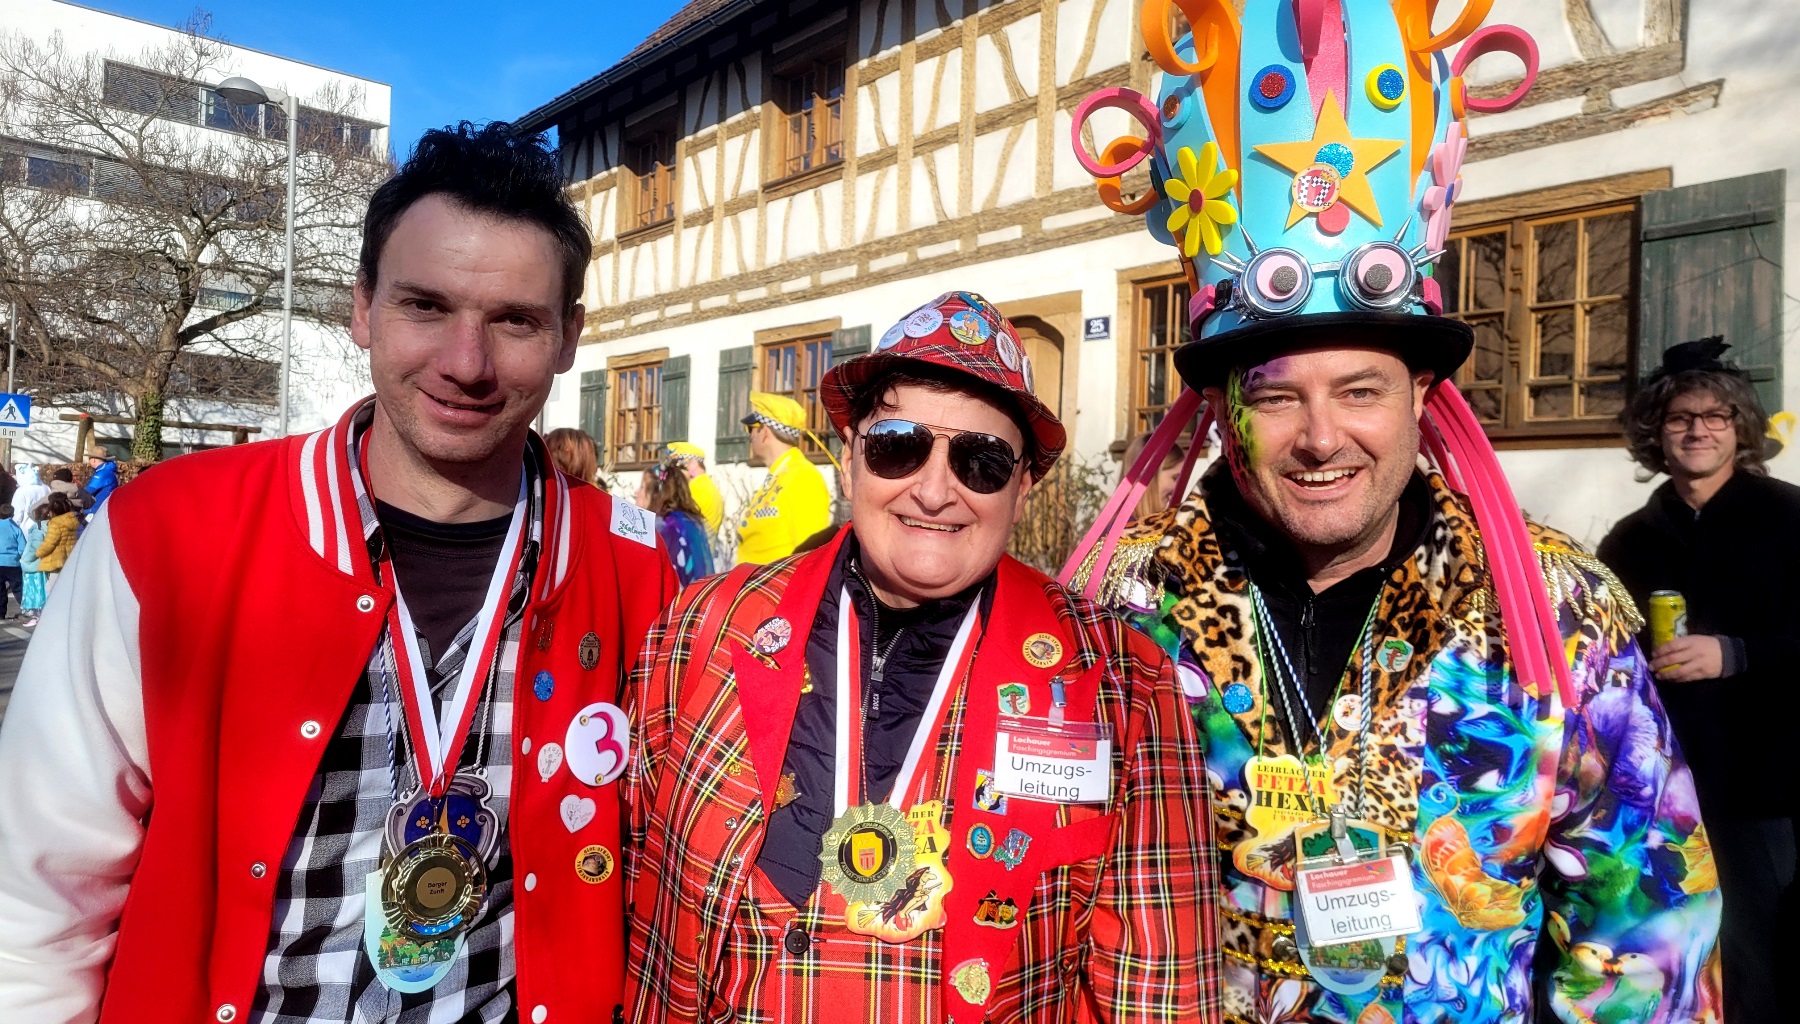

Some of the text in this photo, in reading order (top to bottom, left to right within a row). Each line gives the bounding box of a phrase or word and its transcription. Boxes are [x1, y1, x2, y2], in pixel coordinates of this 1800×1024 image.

[1090, 318, 1105, 333] 25
[872, 693, 880, 711] SOCCX
[588, 711, 625, 777] 3
[1012, 744, 1077, 757] Faschingsgremium
[1013, 736, 1051, 747] Lochauer
[1011, 756, 1093, 780] Umzugs-
[1020, 778, 1080, 801] leitung
[1256, 773, 1326, 795] FETZA
[1255, 789, 1327, 814] HEXA
[1310, 869, 1348, 880] Lochauer
[1311, 874, 1376, 889] Faschingsgremium
[1315, 890, 1397, 912] Umzugs-
[1331, 914, 1392, 935] leitung
